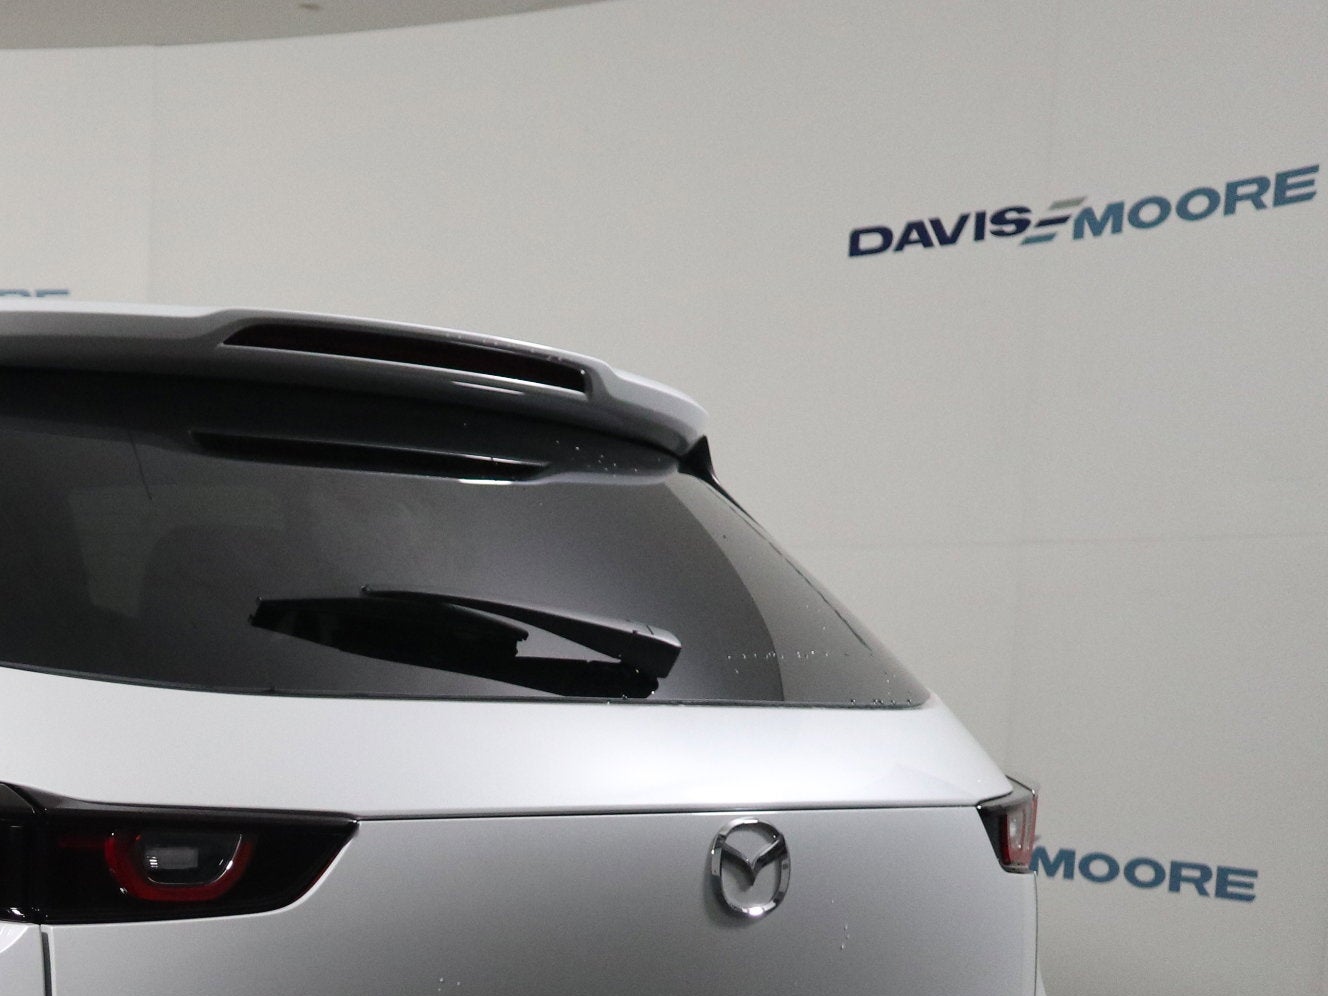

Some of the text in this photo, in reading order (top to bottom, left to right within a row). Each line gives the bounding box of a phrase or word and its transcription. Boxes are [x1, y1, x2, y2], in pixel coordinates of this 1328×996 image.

[848, 164, 1320, 257] DAVIS MOORE
[1029, 845, 1258, 902] MOORE
